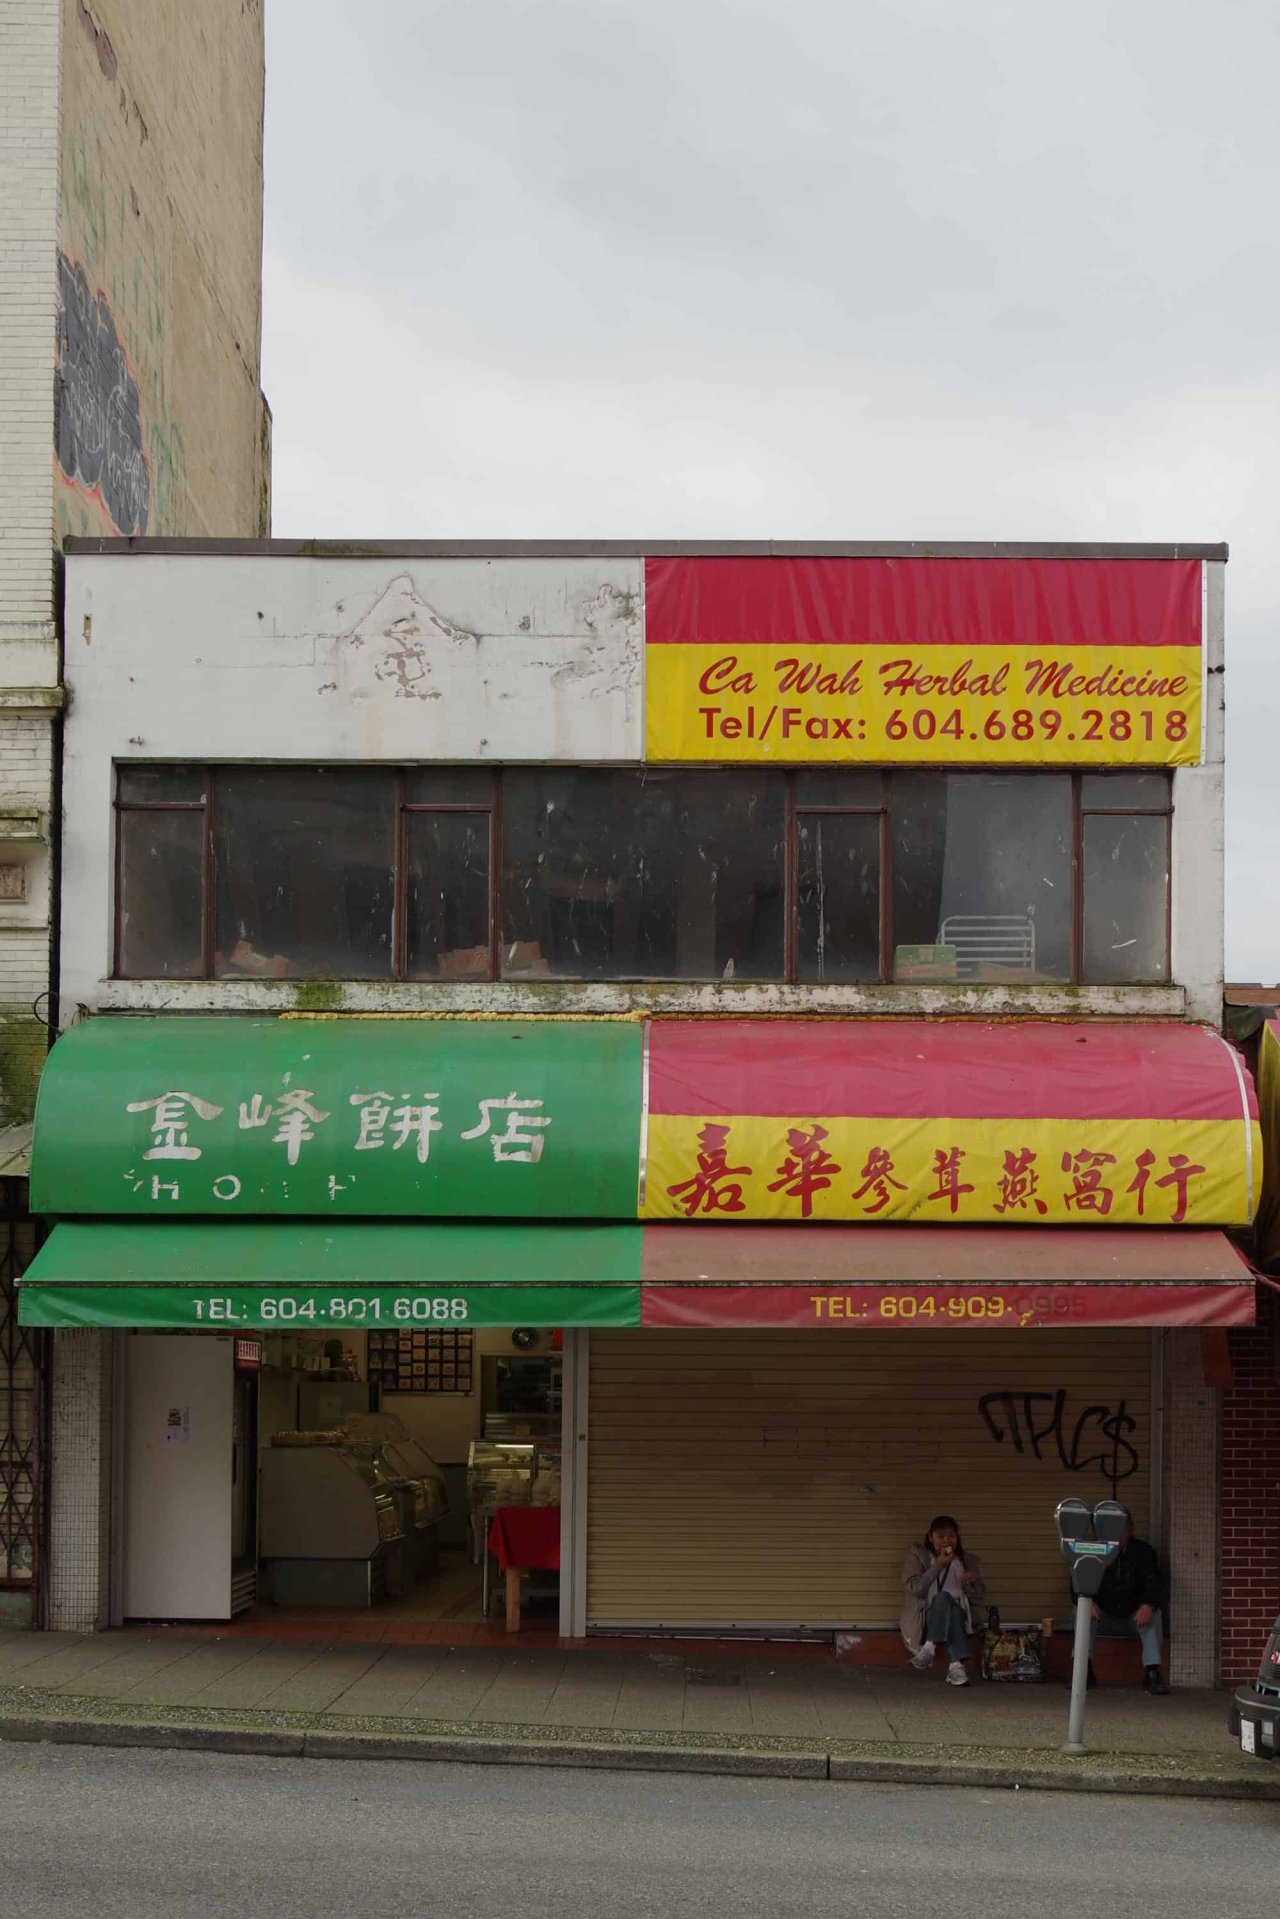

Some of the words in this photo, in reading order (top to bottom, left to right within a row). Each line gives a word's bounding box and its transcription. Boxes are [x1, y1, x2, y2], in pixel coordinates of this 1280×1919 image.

[699, 656, 758, 695] Ca
[774, 658, 863, 696] Wah
[878, 658, 1011, 697] Herbal
[1024, 659, 1189, 698] Medicine
[698, 705, 867, 741] Tel/Fax:
[885, 708, 1188, 742] 604.689.2818
[193, 1298, 249, 1320] TEL:
[810, 1296, 868, 1318] TEL:
